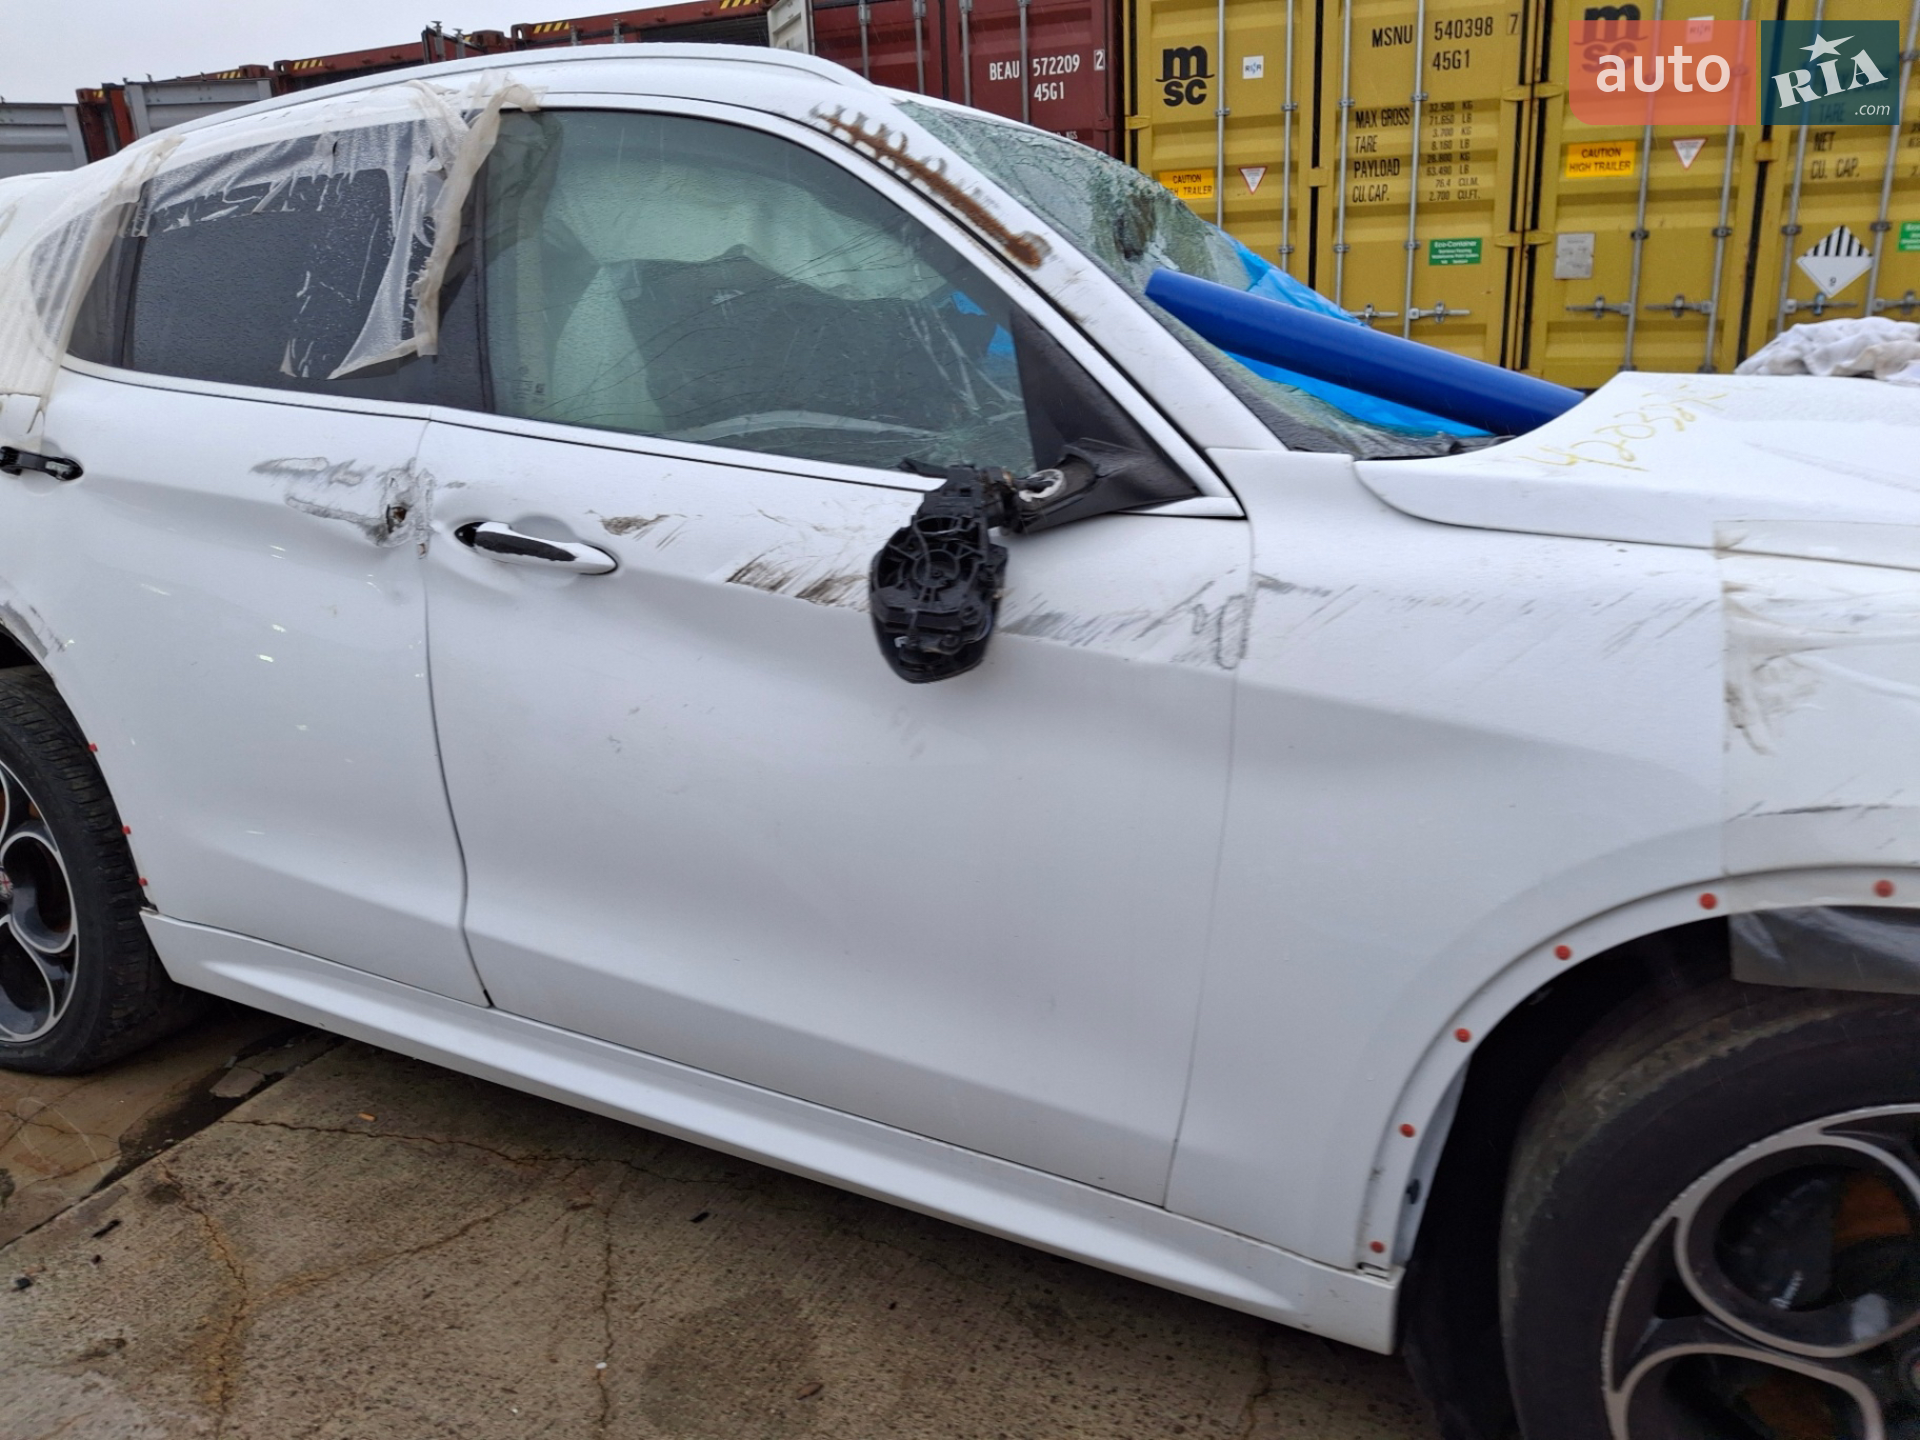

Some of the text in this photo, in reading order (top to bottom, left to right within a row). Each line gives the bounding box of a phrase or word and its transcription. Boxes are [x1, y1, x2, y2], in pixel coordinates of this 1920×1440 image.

[1372, 14, 1519, 47] MSNU 540398 7
[989, 49, 1106, 81] BEAU 572209 2
[1432, 49, 1471, 71] 45G1
[1033, 81, 1065, 101] 45G1
[1355, 107, 1411, 129] MAX GROSS
[1355, 135, 1378, 153] TARE
[1813, 131, 1836, 151] NET
[1581, 147, 1622, 159] CAUTION
[1354, 158, 1400, 178] PAYLOAD
[1568, 160, 1631, 173] HIGH TRAILER
[1172, 174, 1202, 184] CAUTION
[1183, 185, 1213, 195] TRAILER
